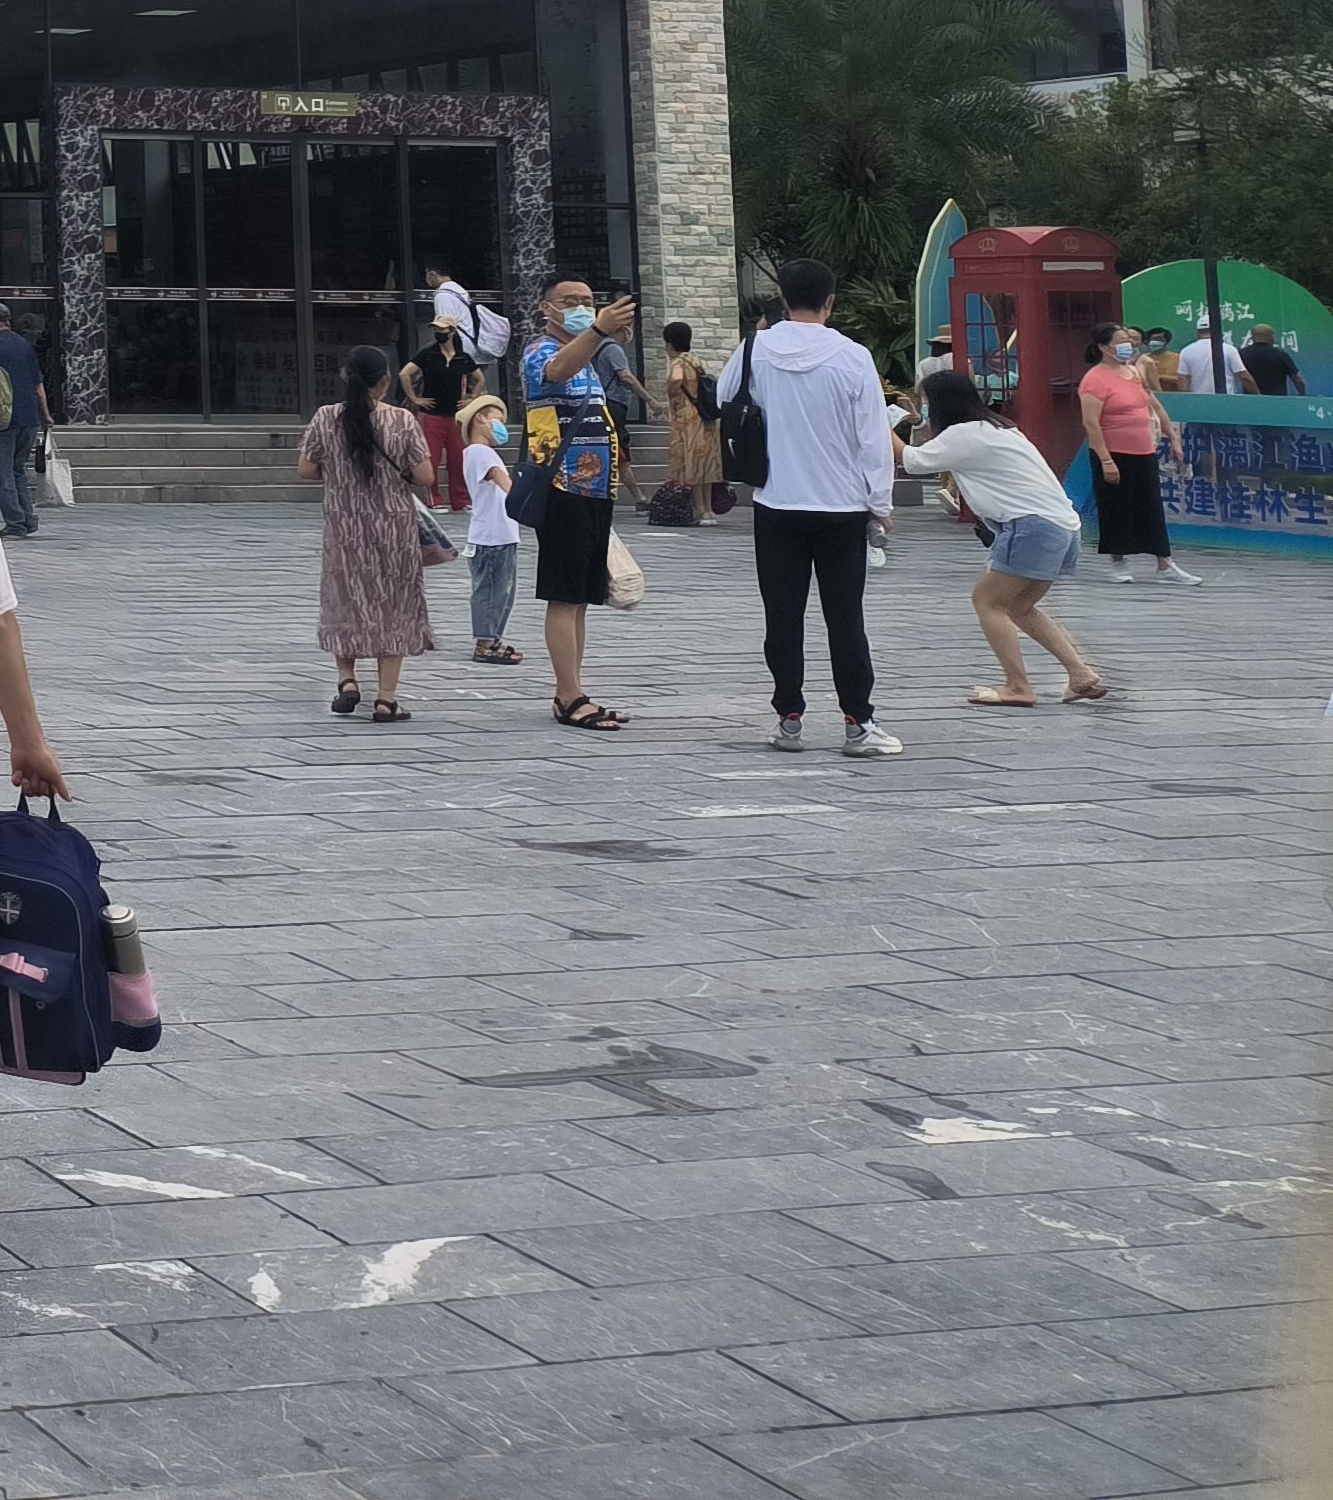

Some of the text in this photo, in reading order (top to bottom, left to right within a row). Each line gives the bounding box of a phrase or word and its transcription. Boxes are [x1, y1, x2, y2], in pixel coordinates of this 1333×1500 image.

[294, 96, 324, 112] 入口
[1156, 425, 1333, 473] 护漓江渔
[1158, 475, 1329, 526] 共建桂林生
